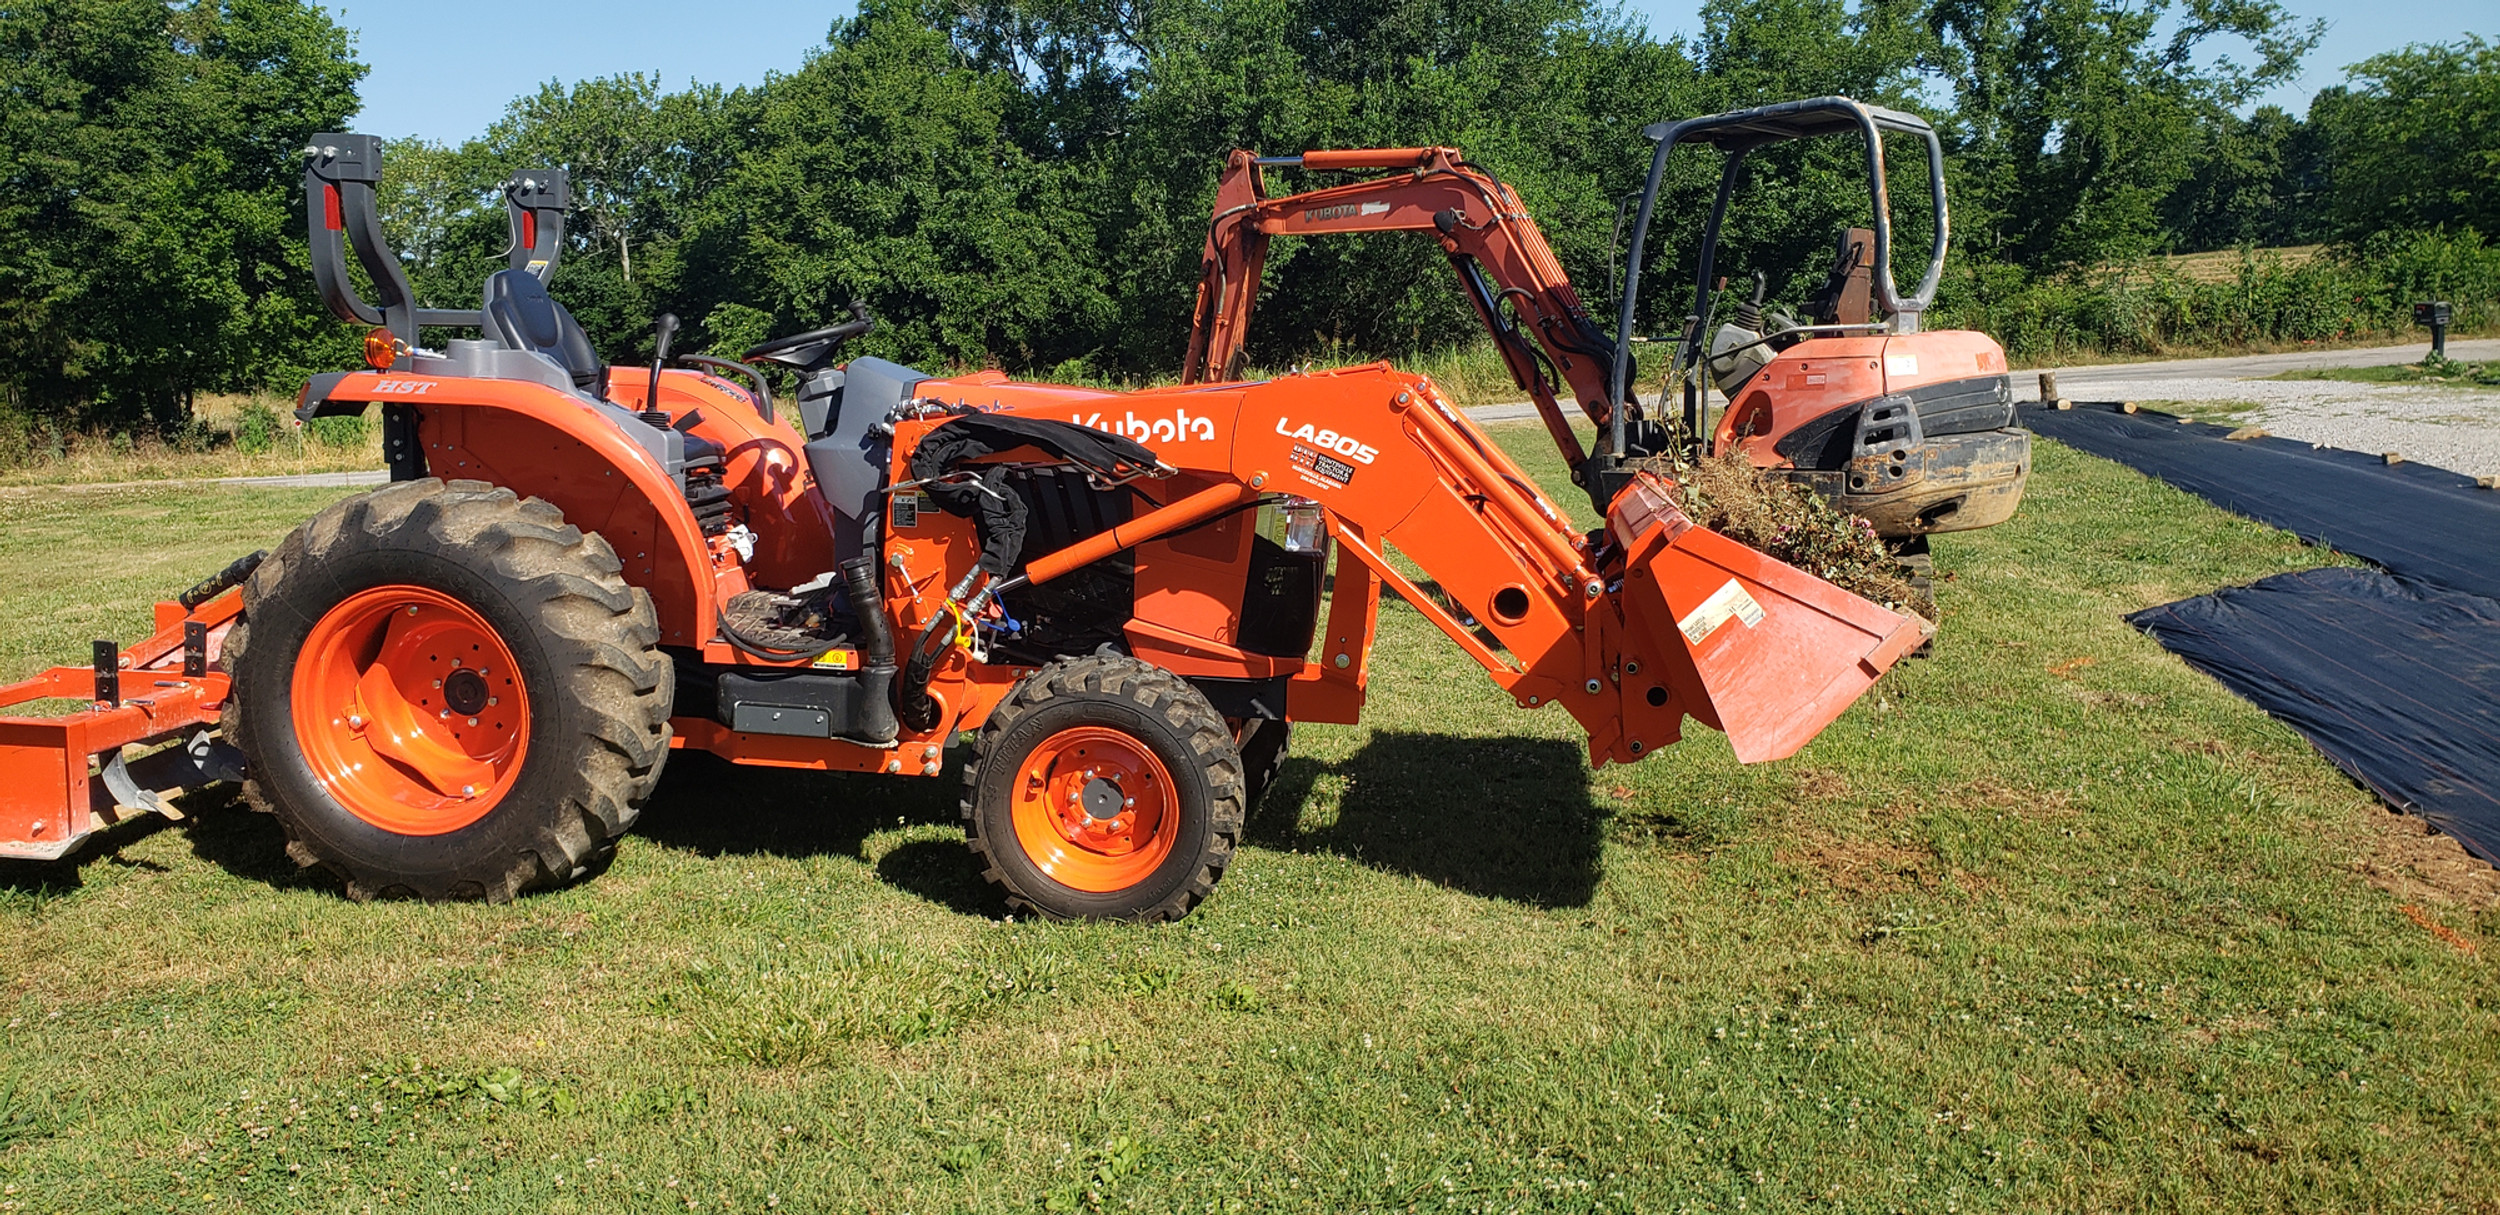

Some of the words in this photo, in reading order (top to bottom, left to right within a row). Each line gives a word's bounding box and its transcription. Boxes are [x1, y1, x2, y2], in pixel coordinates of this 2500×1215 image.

[1305, 204, 1358, 223] KUBOTA
[371, 380, 438, 395] HST
[1275, 416, 1380, 465] LA805
